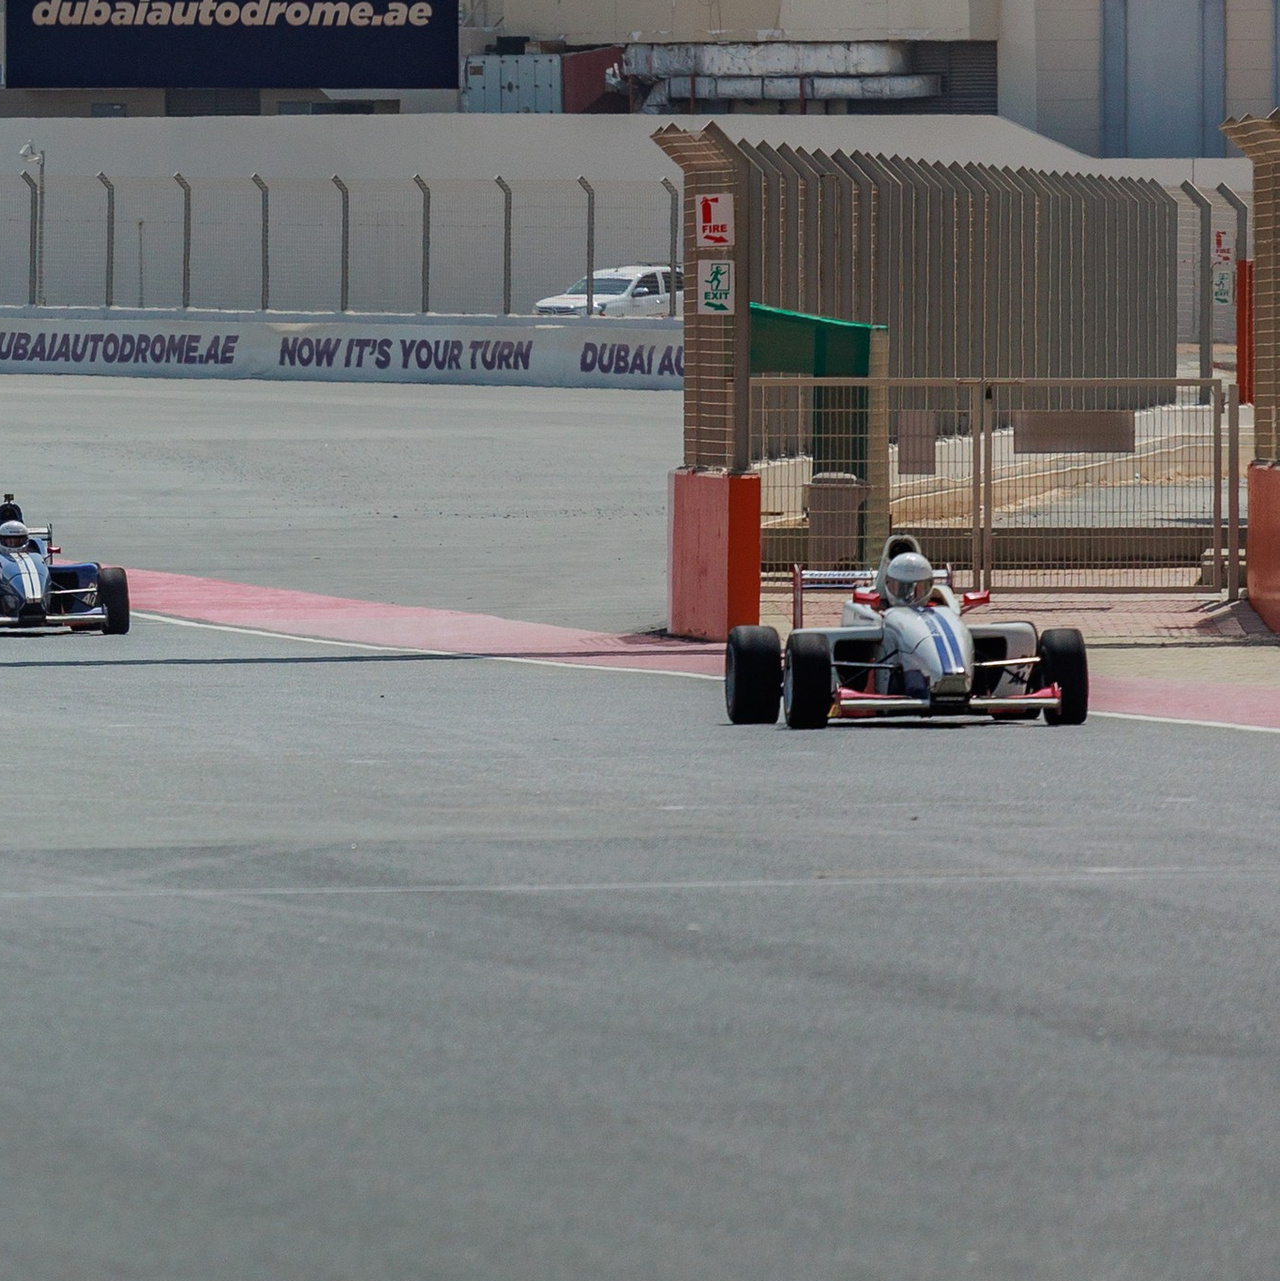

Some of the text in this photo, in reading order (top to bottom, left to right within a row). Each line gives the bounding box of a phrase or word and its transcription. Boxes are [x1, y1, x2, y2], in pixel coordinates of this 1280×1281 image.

[702, 224, 728, 233] FIRE
[704, 291, 730, 300] EXIT
[279, 336, 533, 370] NOW IT'S YOUR TURN
[580, 342, 656, 375] DUBAI
